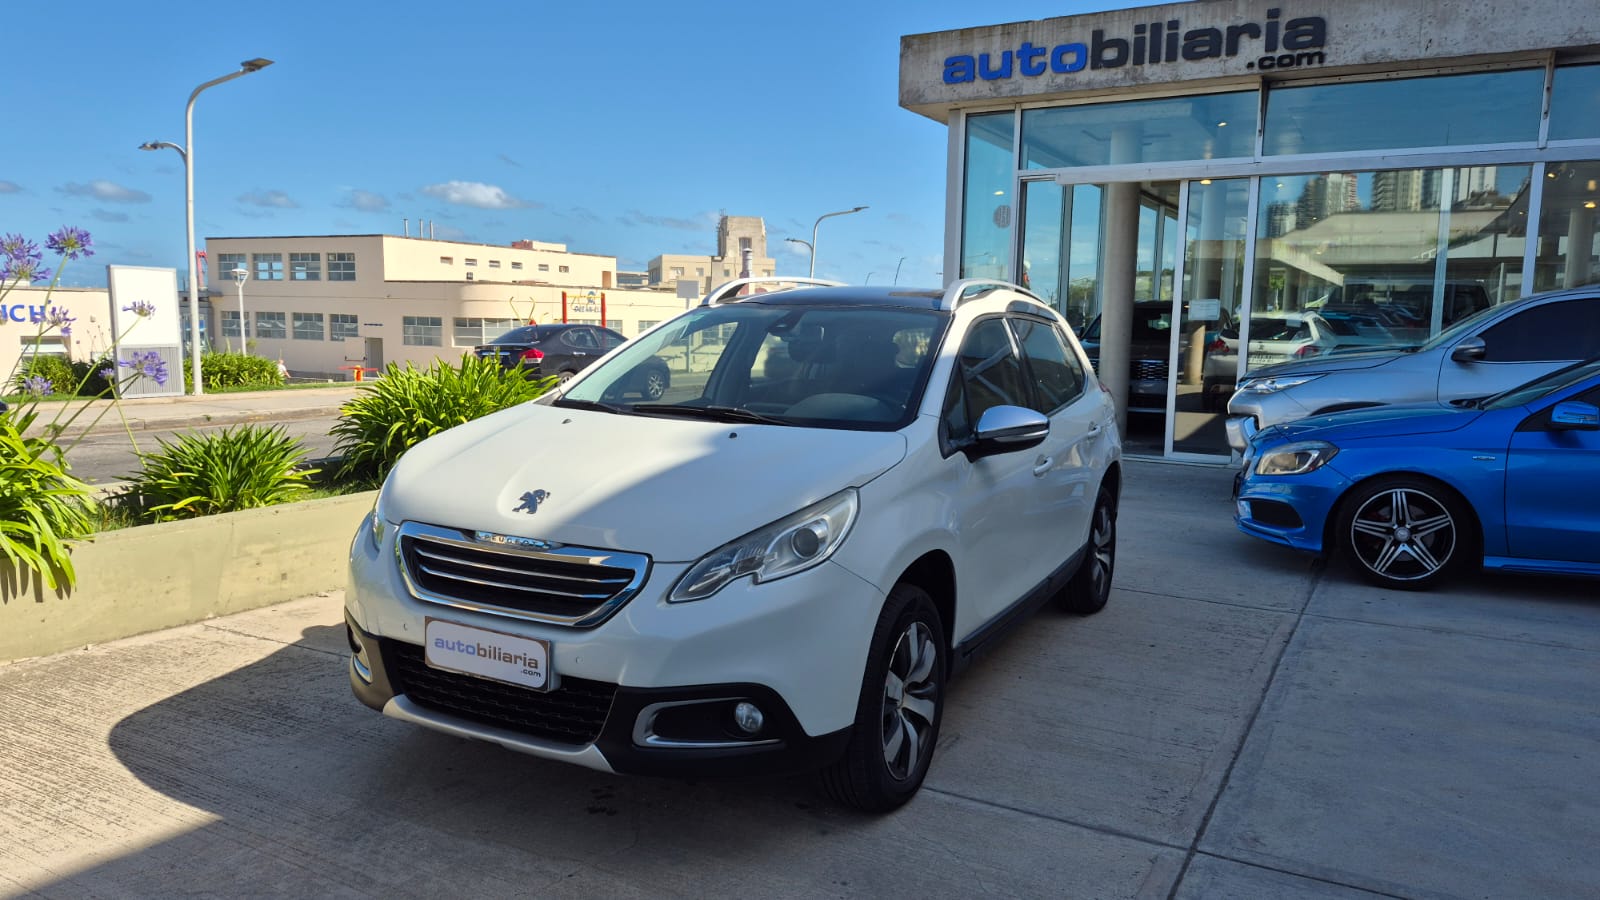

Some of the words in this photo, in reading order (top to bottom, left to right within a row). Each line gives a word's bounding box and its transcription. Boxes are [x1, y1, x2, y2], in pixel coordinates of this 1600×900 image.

[942, 8, 1327, 84] autobiliaria
[1246, 50, 1325, 70] .com
[434, 637, 539, 669] autobiliaria
[520, 667, 541, 678] .com
